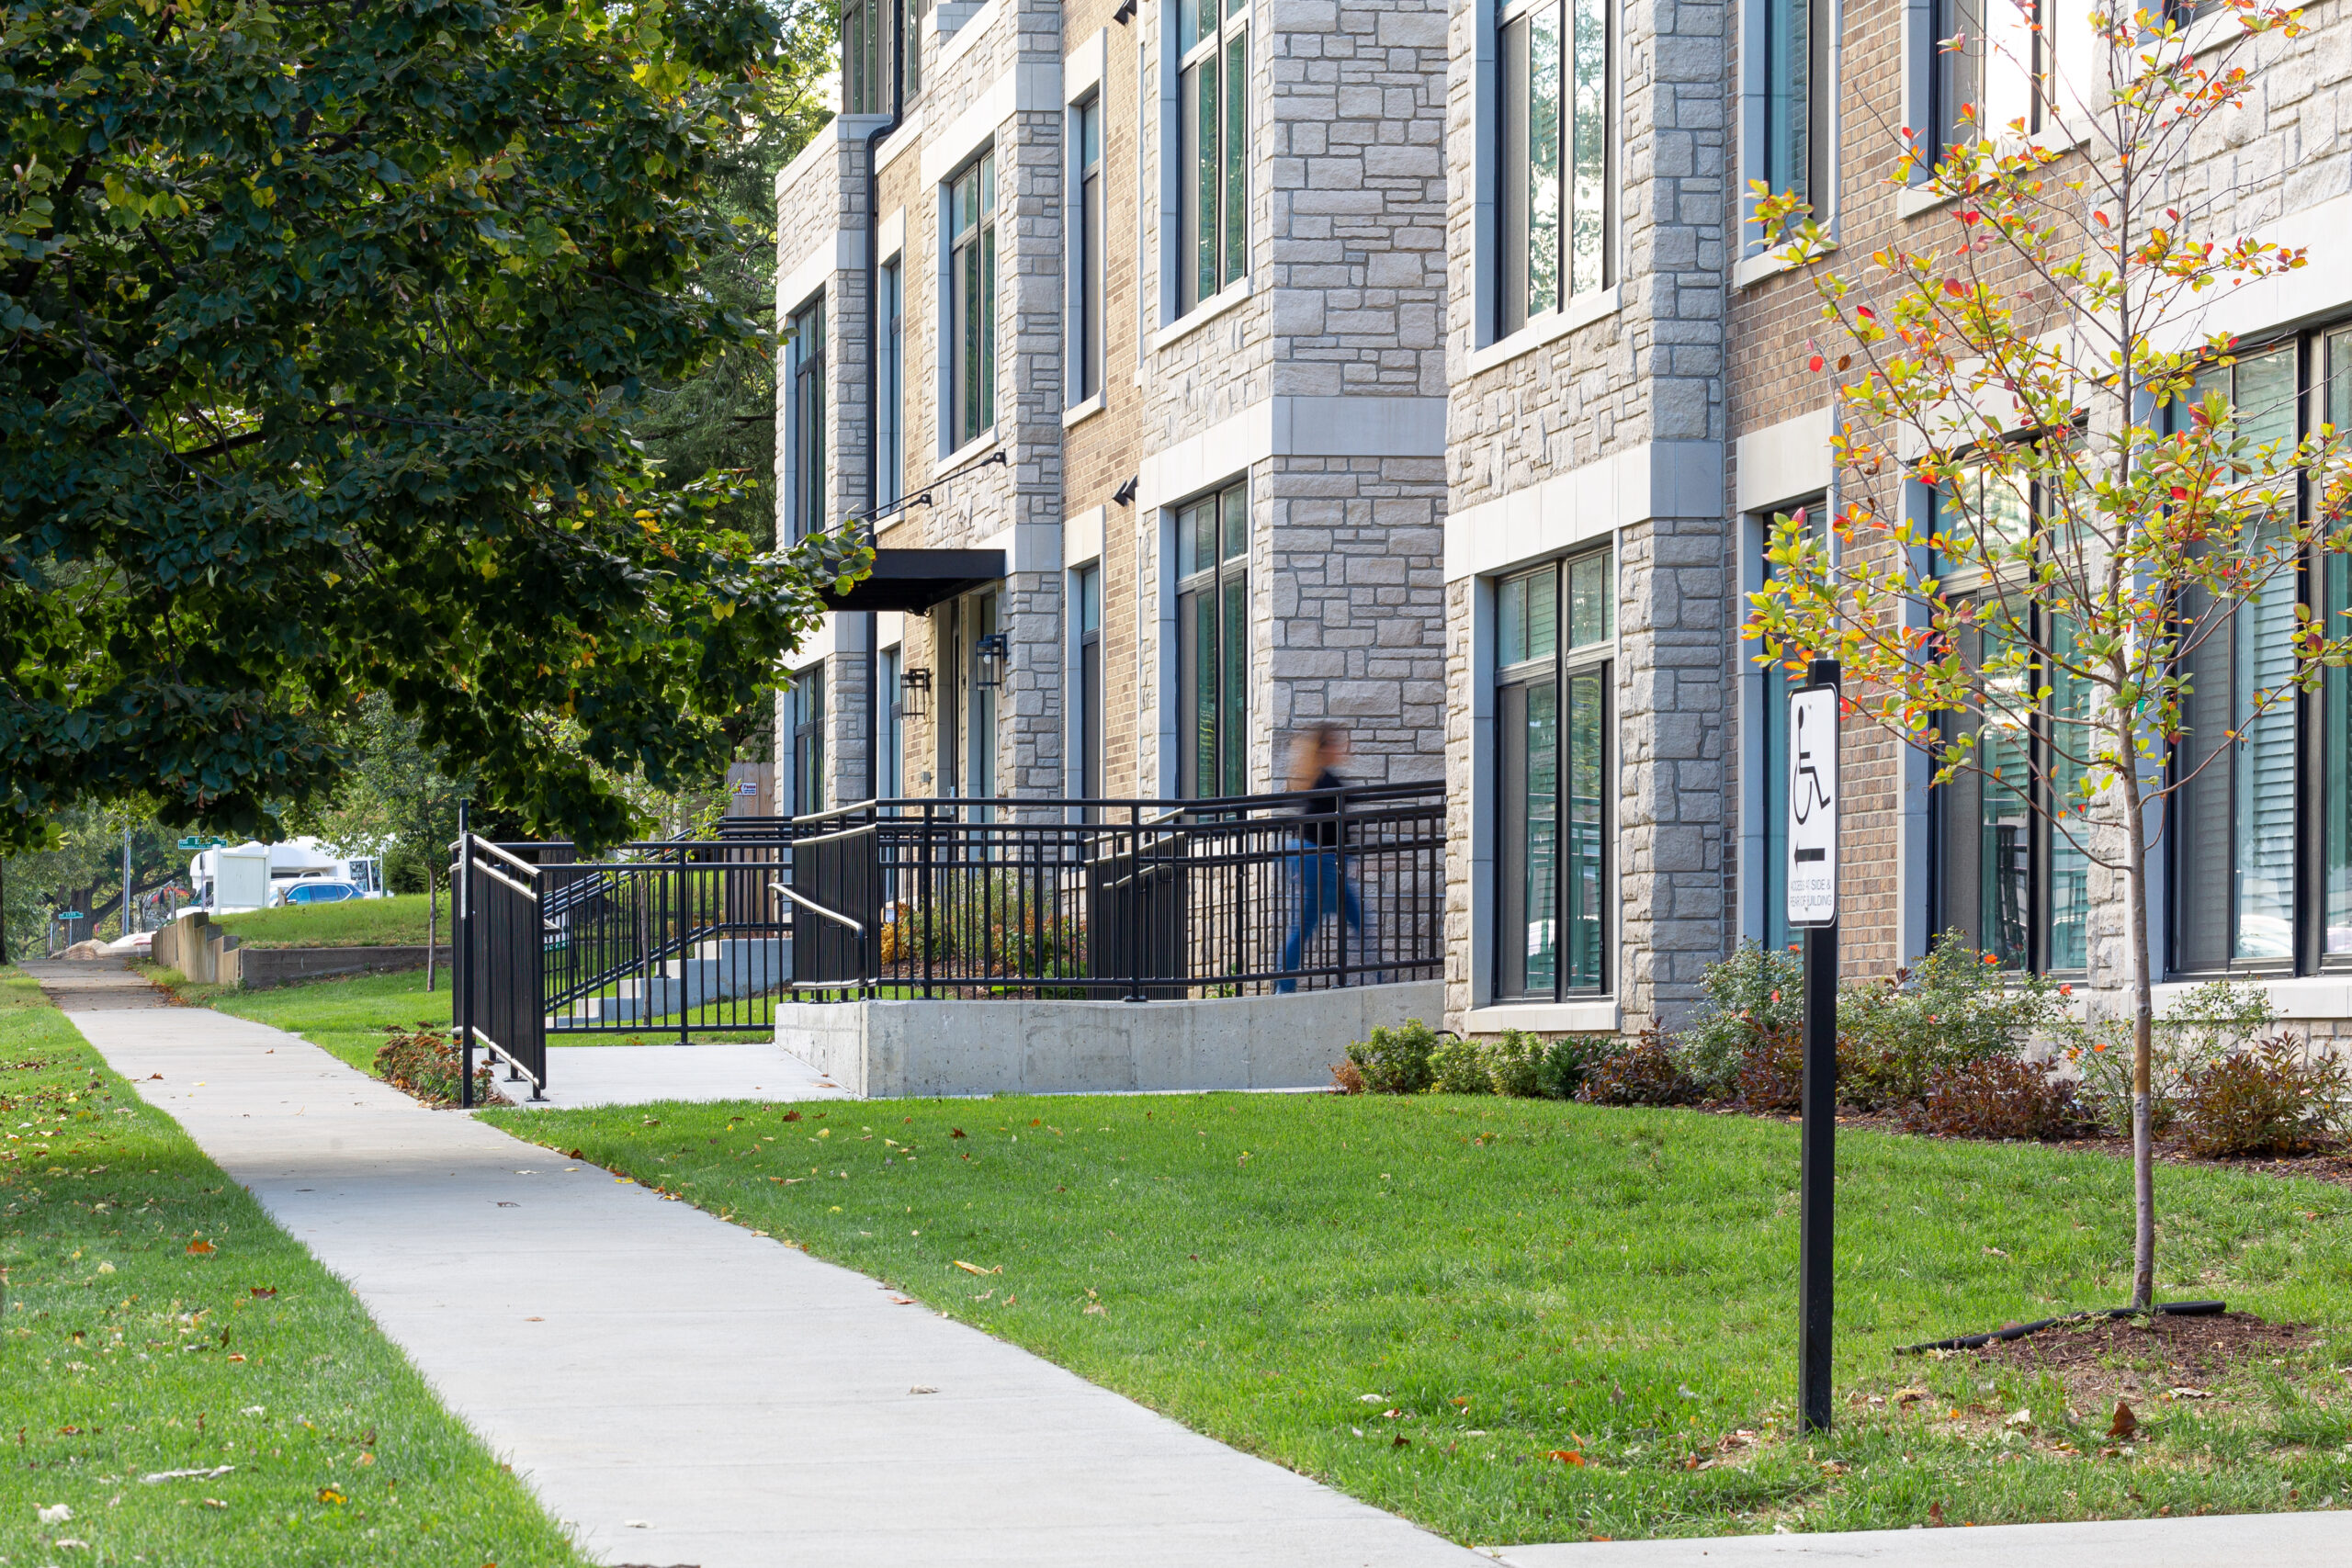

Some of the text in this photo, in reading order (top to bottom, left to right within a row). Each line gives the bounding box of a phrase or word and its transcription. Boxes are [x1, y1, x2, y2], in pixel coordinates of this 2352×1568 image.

[1811, 878, 1826, 890] SIDE
[1826, 878, 1831, 890] &
[1806, 895, 1832, 907] UILDING
